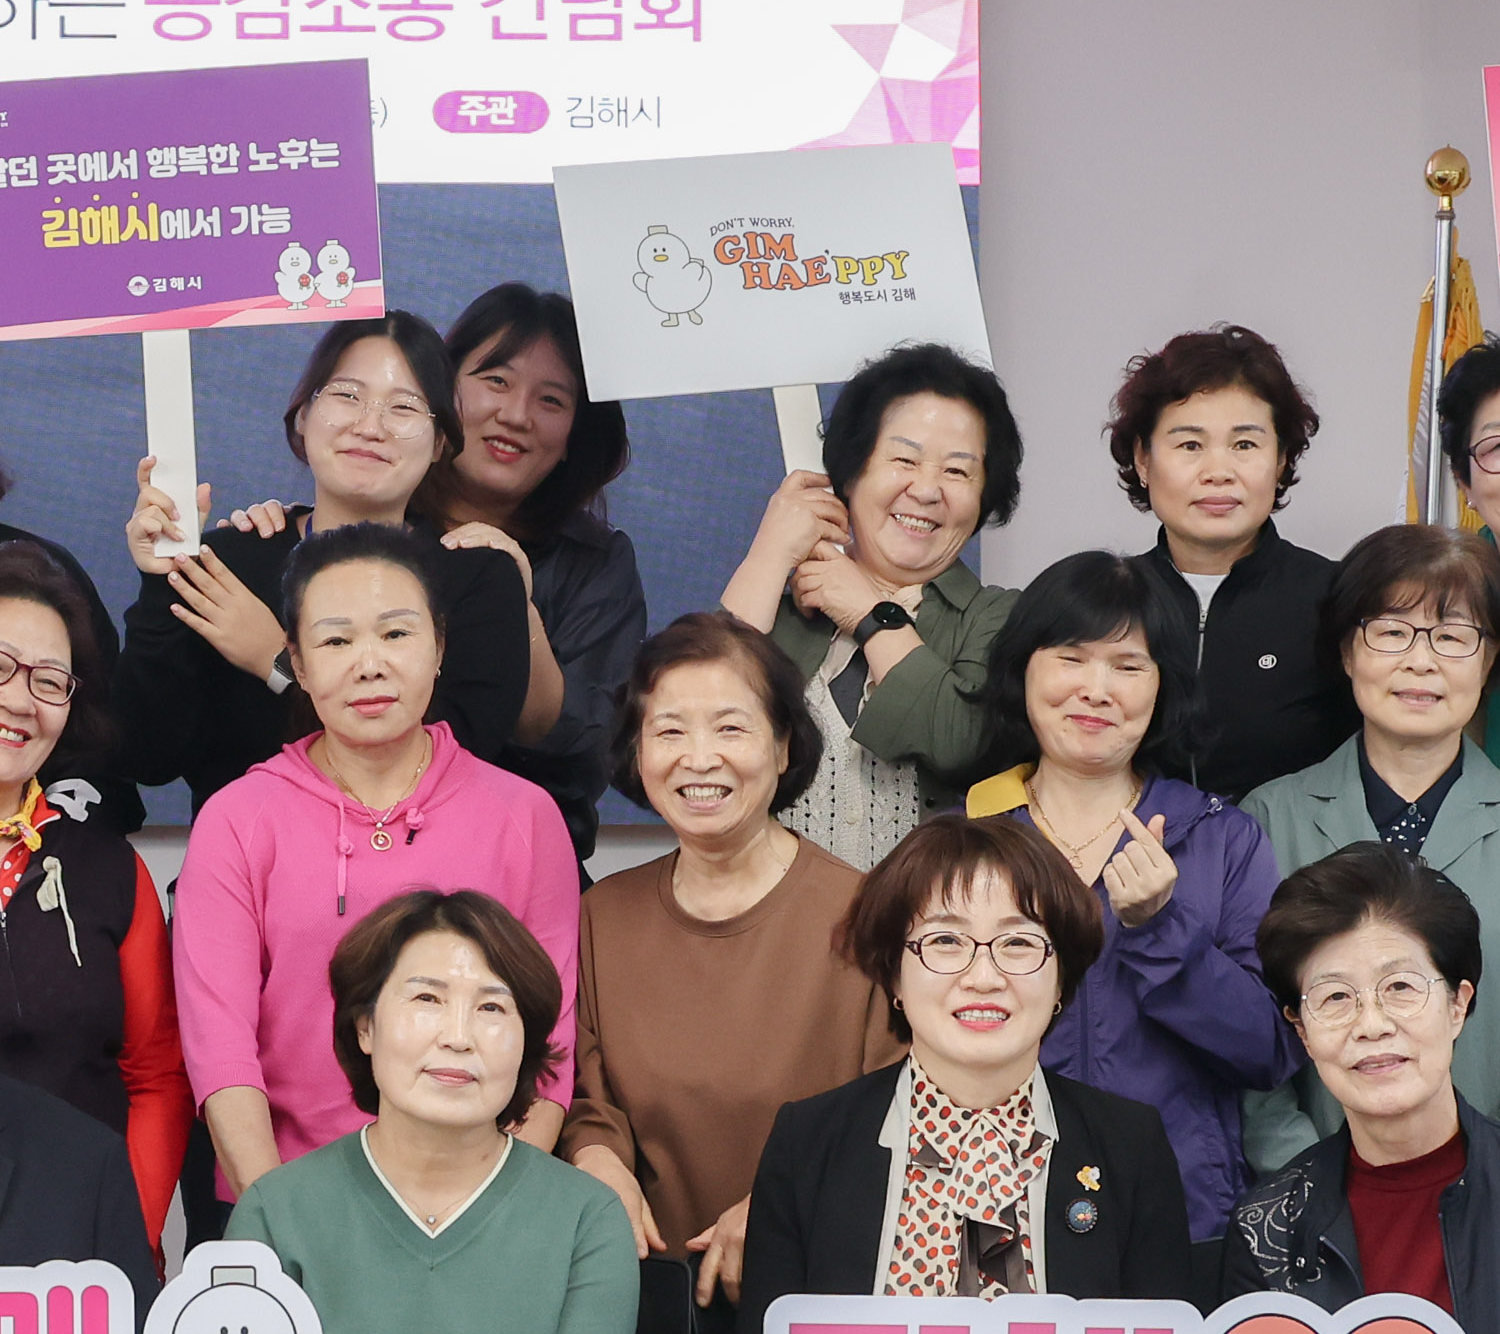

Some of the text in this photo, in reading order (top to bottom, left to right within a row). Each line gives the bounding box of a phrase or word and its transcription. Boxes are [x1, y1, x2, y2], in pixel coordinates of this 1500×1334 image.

[457, 95, 517, 126] 주관
[566, 96, 660, 128] 김해시
[47, 149, 138, 185] 곳에서
[146, 143, 240, 177] 행복한
[248, 138, 340, 171] 노후는
[41, 201, 291, 248] 김해시에서 가능
[709, 217, 745, 237] DON'T
[713, 232, 798, 265] GIM
[152, 275, 202, 292] 김해시
[838, 288, 916, 305] 행복도시 김해
